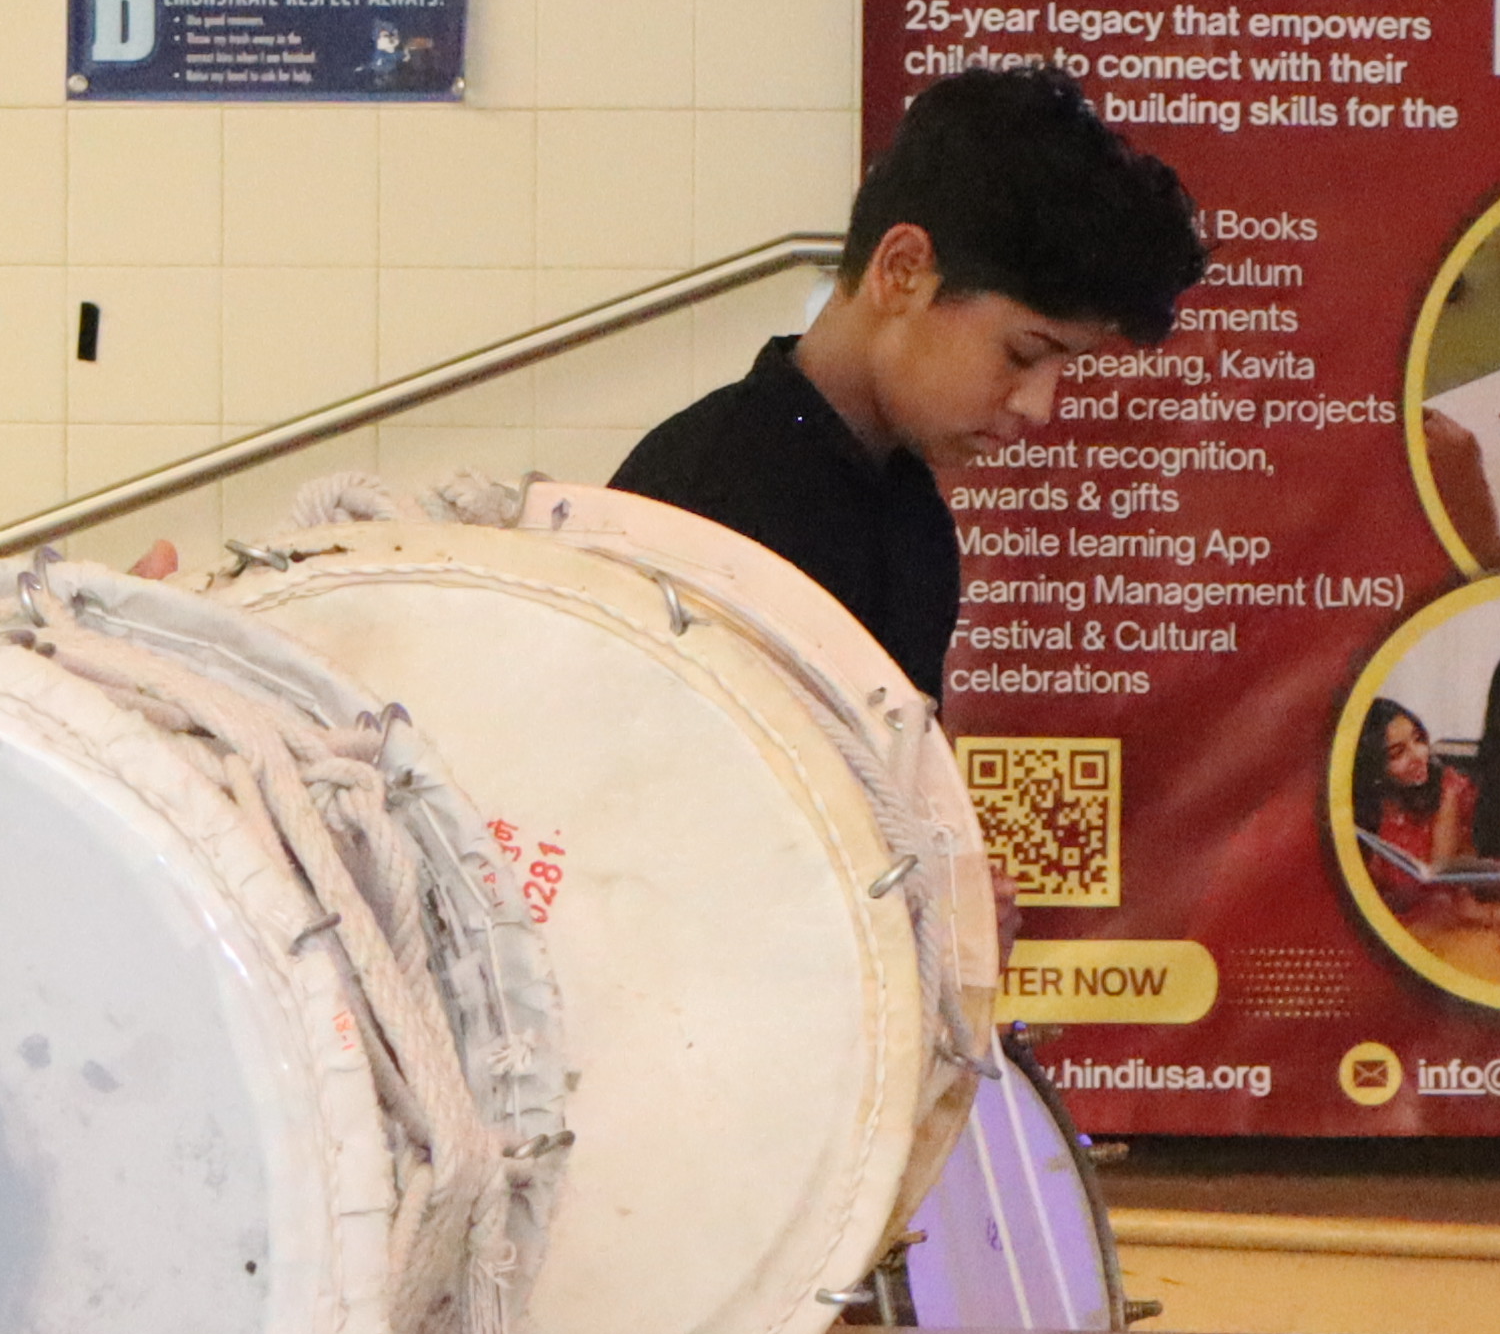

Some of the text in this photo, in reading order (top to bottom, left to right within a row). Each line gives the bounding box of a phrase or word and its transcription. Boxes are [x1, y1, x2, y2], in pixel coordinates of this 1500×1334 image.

[904, 0, 1432, 45] 25-year legacy that empowers
[1053, 46, 1090, 78] to
[1098, 50, 1242, 81] connect
[1250, 51, 1321, 83] with
[1329, 52, 1408, 85] their
[1105, 92, 1241, 133] building
[1250, 95, 1338, 126] skills
[1346, 97, 1395, 128] for
[1402, 98, 1459, 129] the
[1216, 209, 1319, 241] Books
[1220, 349, 1316, 380] Kavita
[1060, 390, 1397, 430] and creative projects
[1087, 442, 1275, 477] recognition,
[950, 481, 1180, 518] awards & gifts
[955, 525, 1271, 566] Mobile learning App
[1094, 574, 1307, 613] Management
[1314, 573, 1405, 611] (LMS)
[950, 618, 1238, 653] Festival & Cultural
[950, 662, 1150, 694] celebrations
[1073, 966, 1169, 998] NOW
